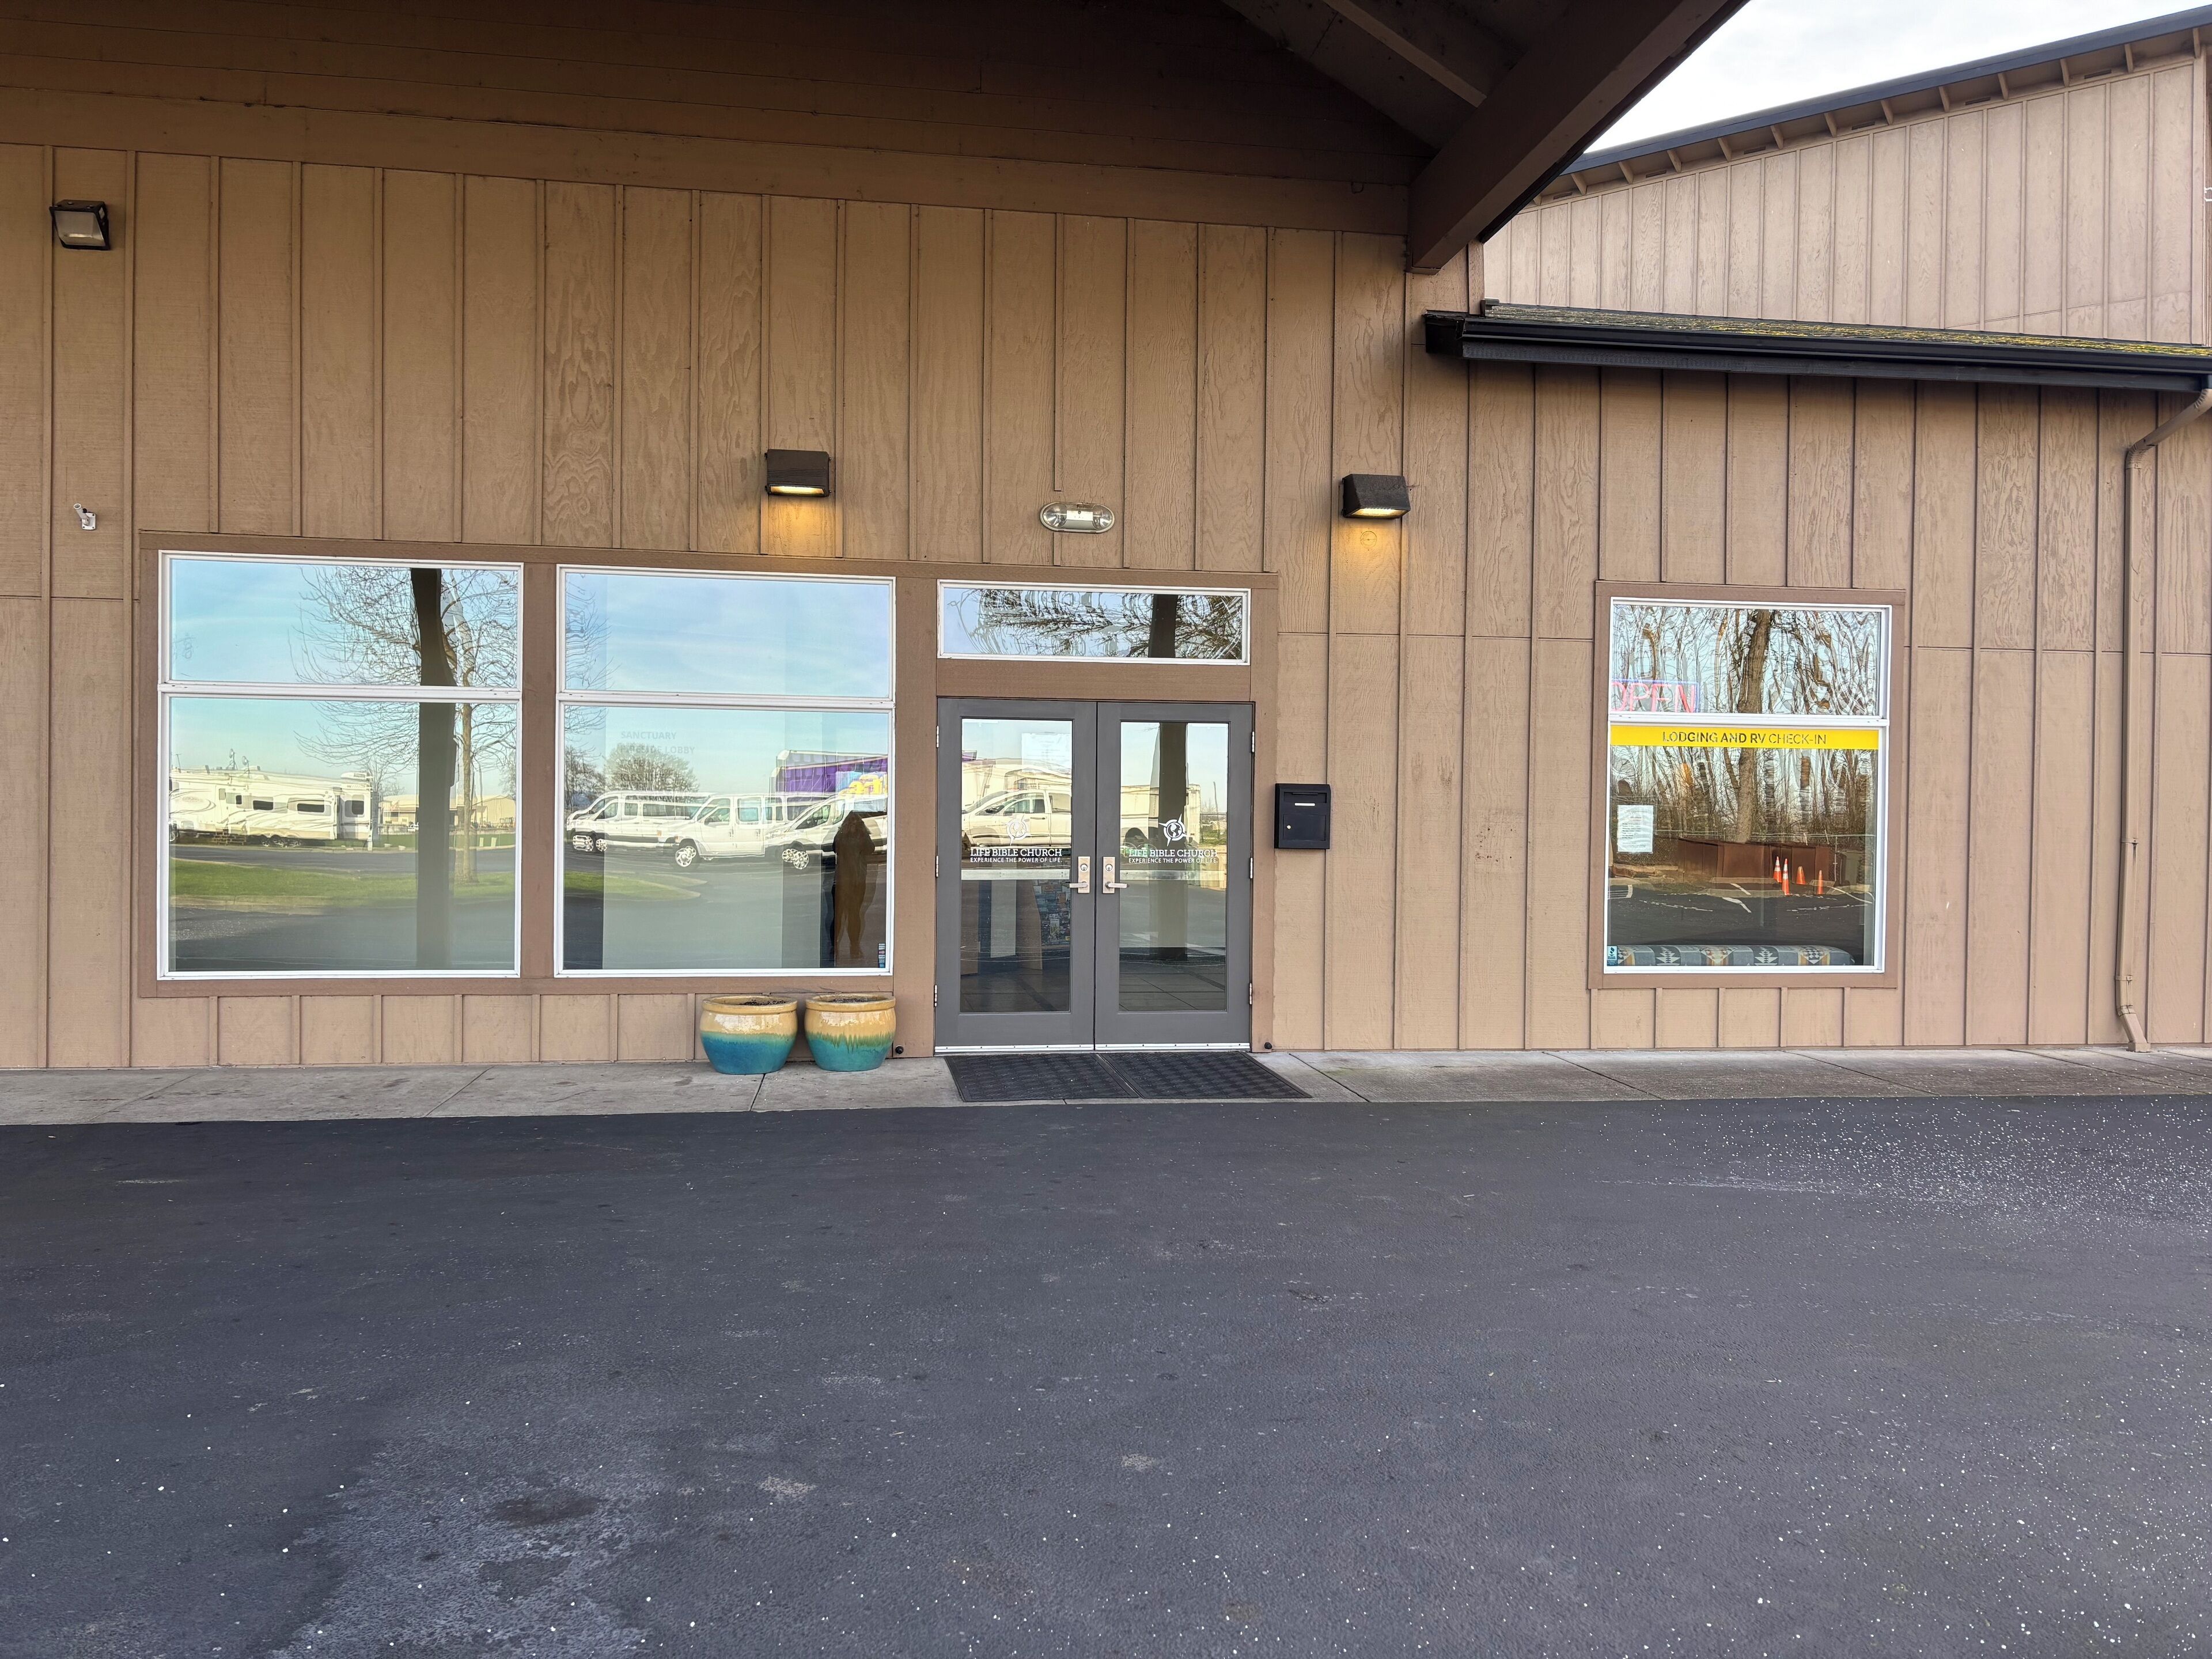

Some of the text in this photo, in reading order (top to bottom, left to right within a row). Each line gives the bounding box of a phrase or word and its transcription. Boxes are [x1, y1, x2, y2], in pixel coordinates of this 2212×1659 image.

[621, 731, 676, 740] SANCTUARY
[1662, 732, 1827, 744] LODGING AND RV CHECK-IN
[665, 746, 695, 754] LOBBY
[970, 849, 1062, 857] LIFE BIBLE CHURCH
[1128, 849, 1148, 857] LIFE
[1177, 850, 1217, 858] CHURCH
